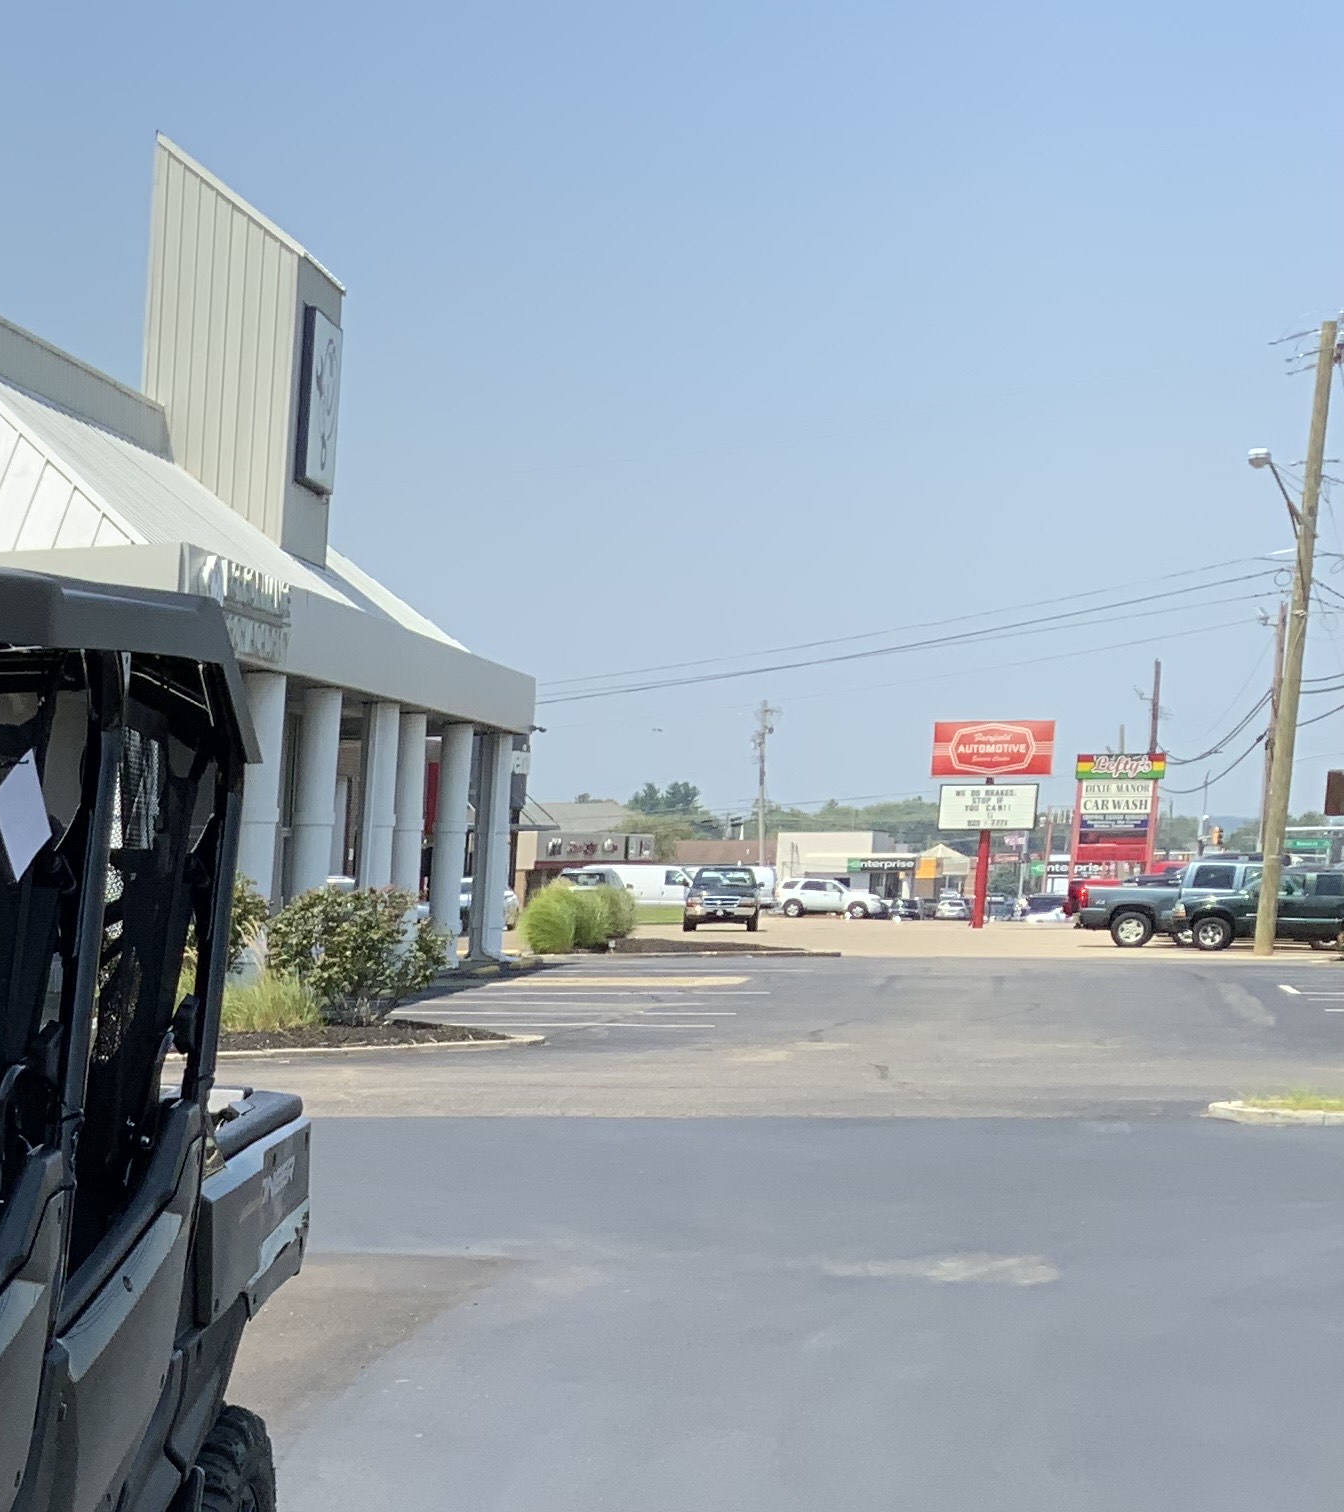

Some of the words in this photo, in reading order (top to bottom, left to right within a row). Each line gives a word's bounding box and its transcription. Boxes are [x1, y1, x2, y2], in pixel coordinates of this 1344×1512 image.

[957, 743, 1027, 753] AUTOMOTIVE
[1091, 755, 1153, 778] Lefty's
[1085, 783, 1111, 793] DIXIE
[1116, 783, 1150, 793] MANOR
[1083, 799, 1109, 811] CAR
[1112, 799, 1148, 811] WASH
[849, 859, 915, 869] enterprise
